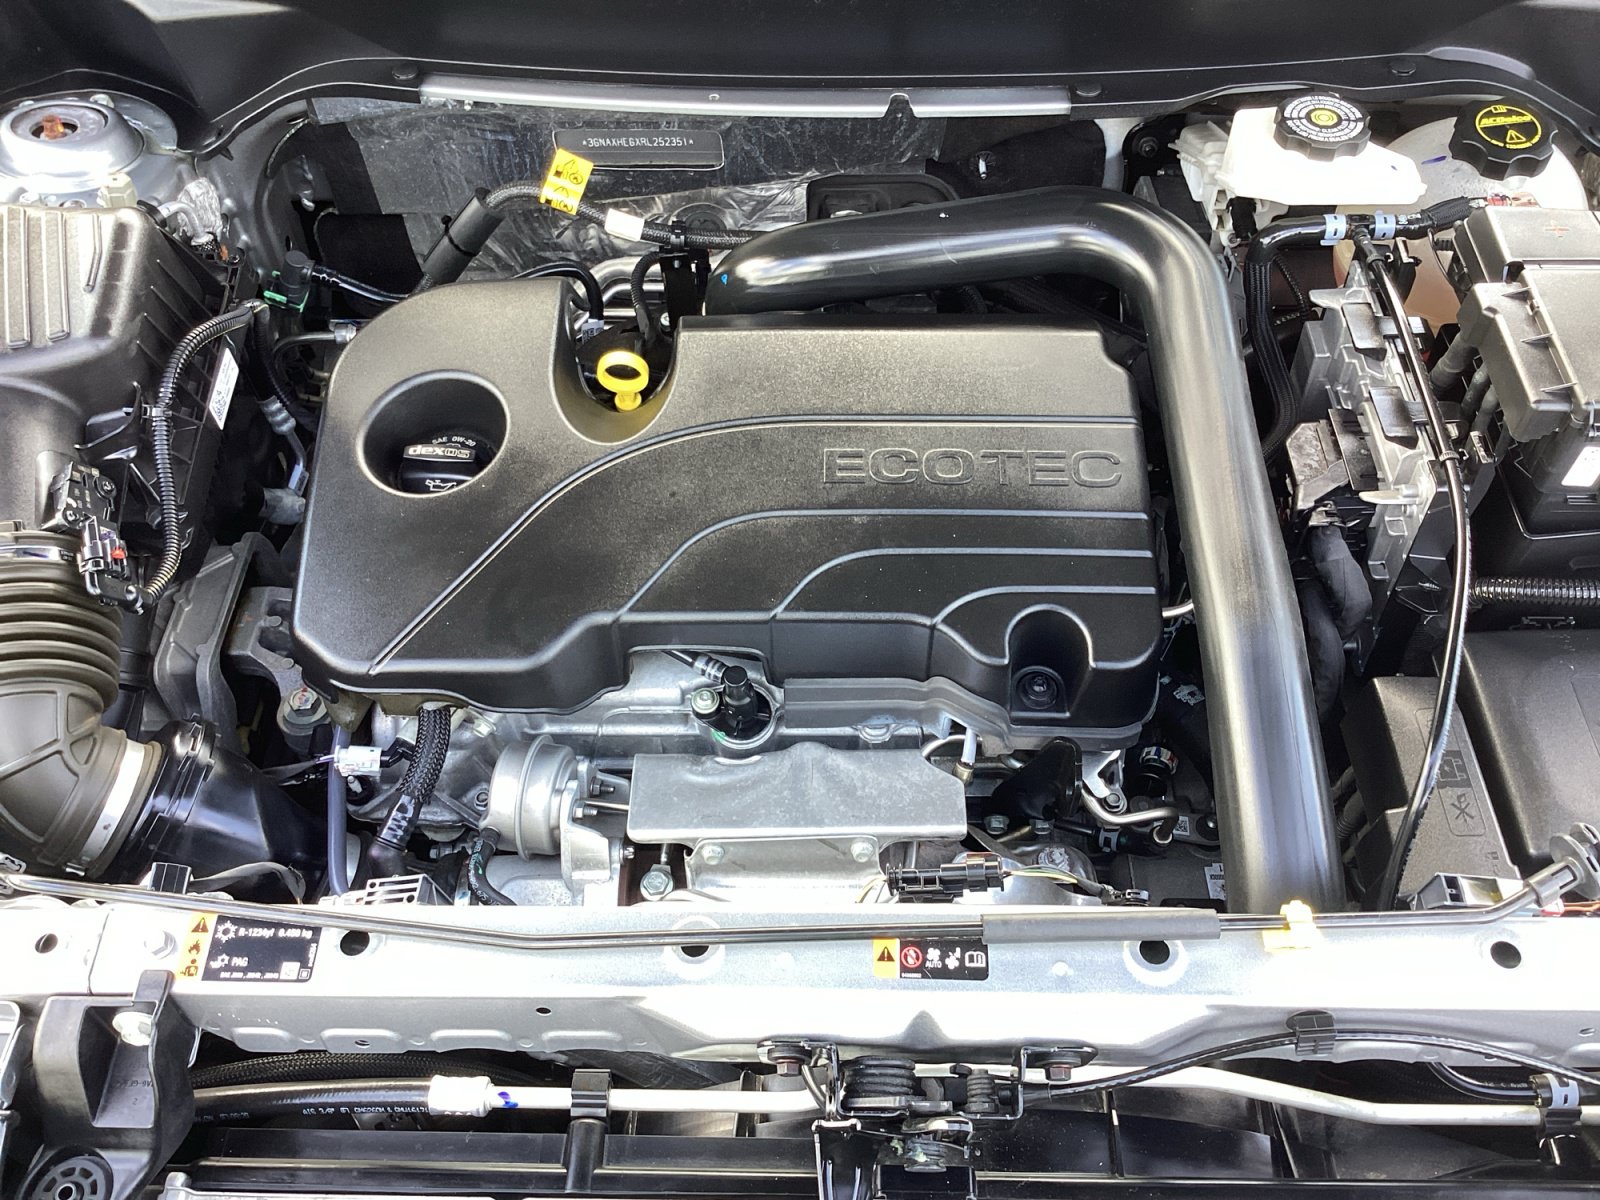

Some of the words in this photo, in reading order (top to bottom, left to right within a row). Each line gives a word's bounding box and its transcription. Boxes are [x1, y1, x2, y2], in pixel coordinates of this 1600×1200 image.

[432, 437, 448, 445] SAE
[451, 436, 477, 447] 0W-20
[408, 445, 471, 459] dexos
[824, 447, 1122, 488] ECOTEC
[231, 957, 249, 967] PAG
[925, 960, 943, 969] AUTO
